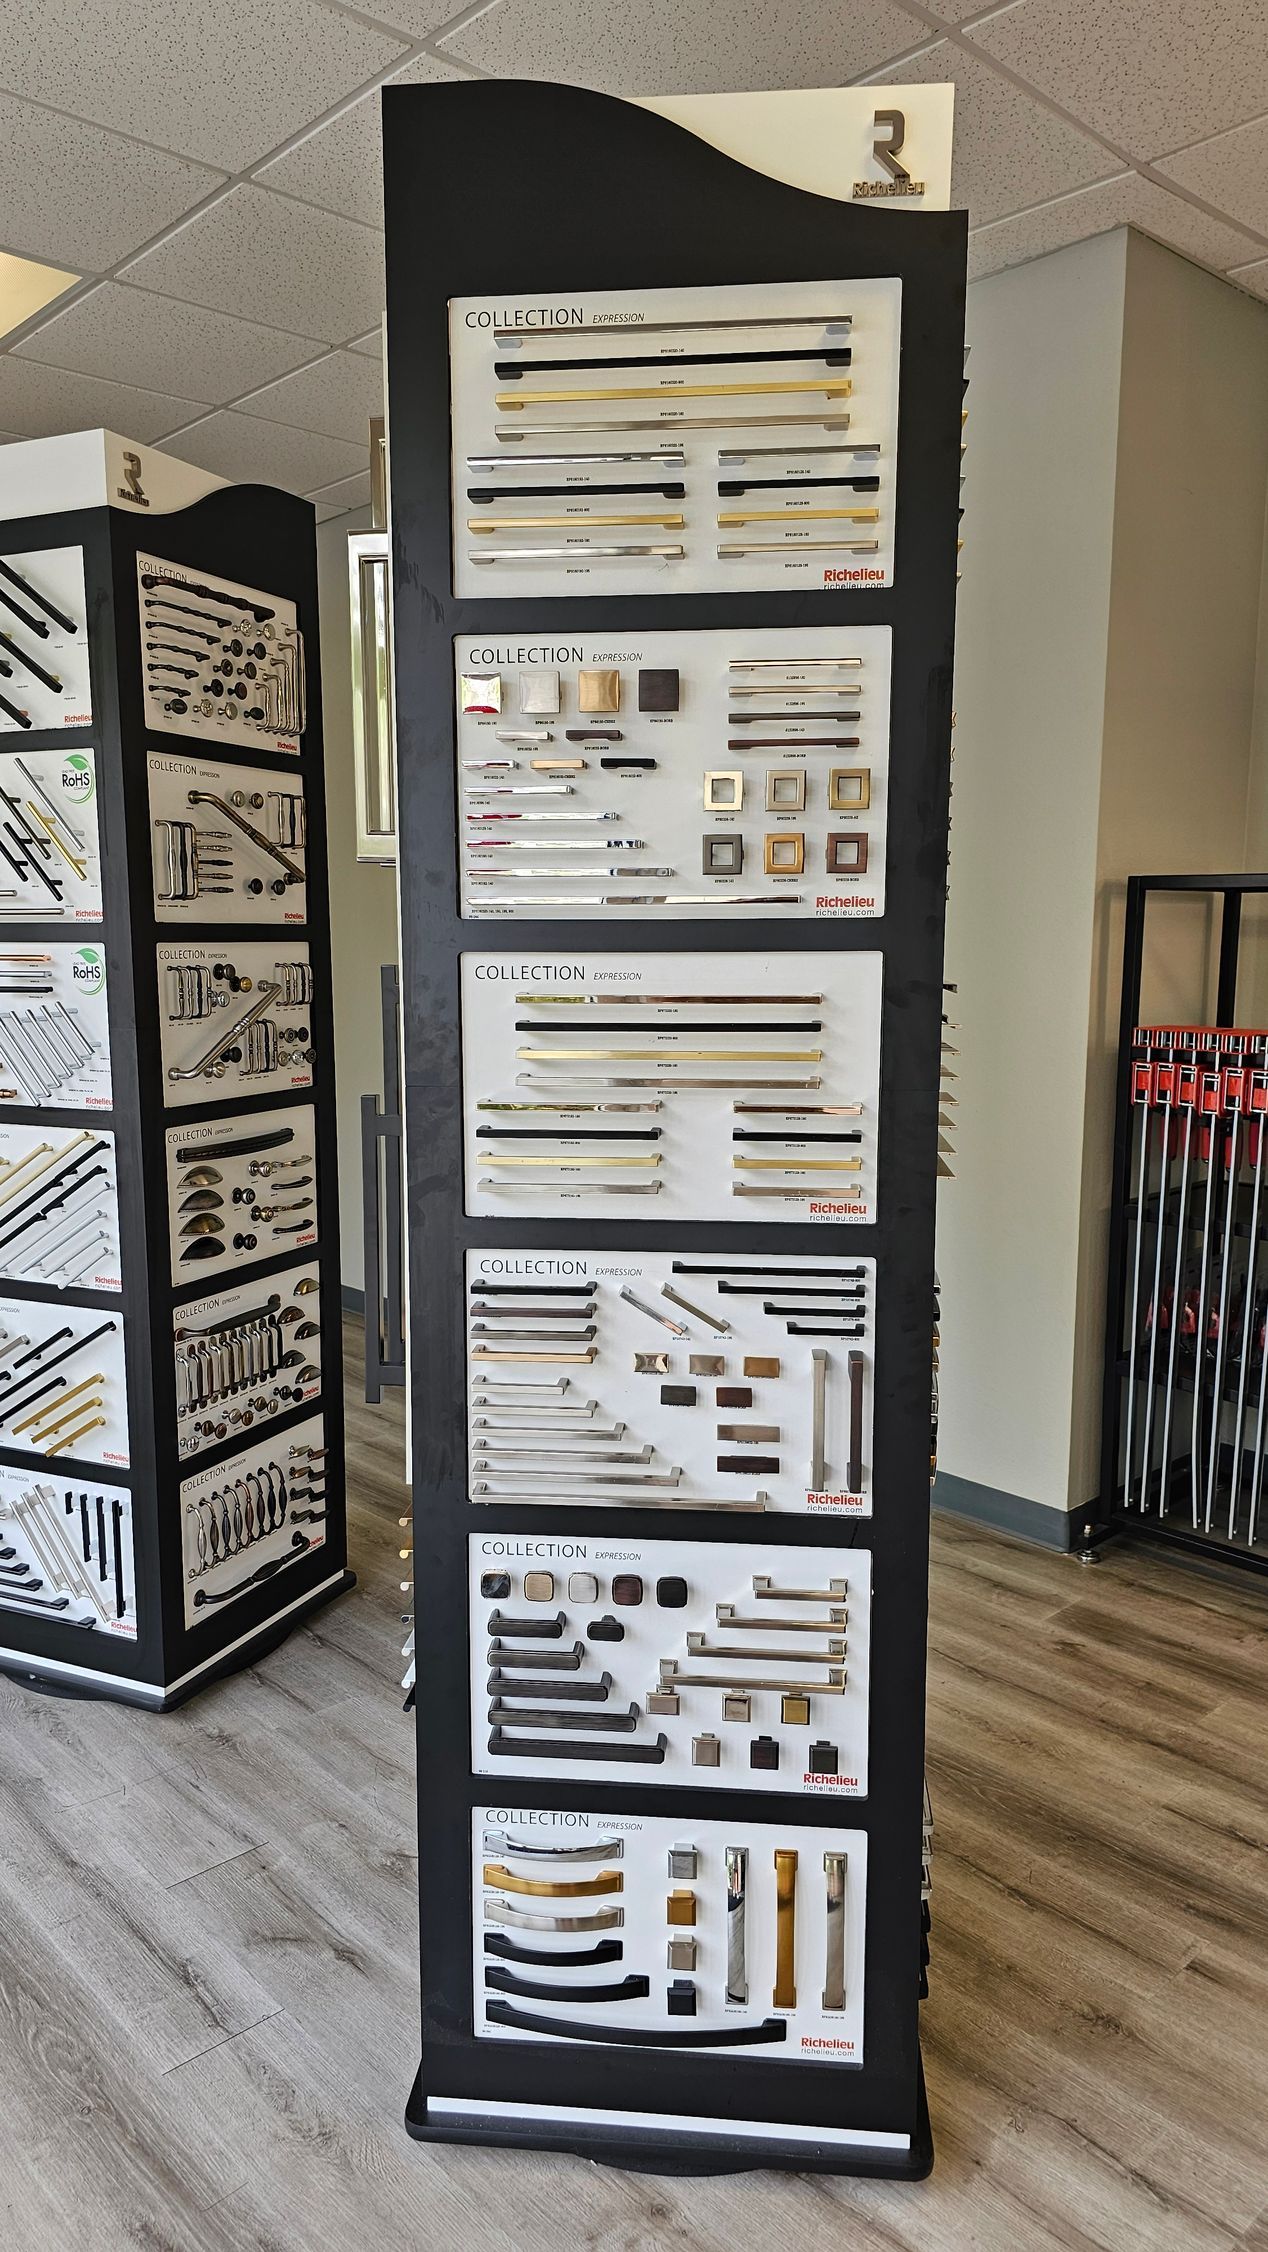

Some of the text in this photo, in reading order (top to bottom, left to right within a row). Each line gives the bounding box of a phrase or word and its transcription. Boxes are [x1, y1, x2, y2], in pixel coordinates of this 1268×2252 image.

[852, 181, 925, 199] Richelieu
[465, 307, 645, 328] COLLECTION EXPRESSION
[138, 560, 188, 584] COLLECTION
[824, 568, 885, 582] Richelieu
[469, 646, 643, 664] COLLECTION EXPRESSION
[149, 759, 198, 776] COLLECTION
[62, 772, 90, 788] RoHS
[816, 896, 875, 909] Richelieu
[816, 908, 875, 917] richelieu.com
[158, 949, 206, 961] COLLECTION
[73, 965, 101, 980] RoHS
[475, 965, 643, 981] COLLECTION EXPRESSION
[167, 1127, 213, 1144] COLLECTION
[810, 1202, 867, 1215] Richelieu
[809, 1213, 867, 1222] richelieu.com
[480, 1259, 643, 1277] COLLECTION EXPRESSION
[175, 1299, 220, 1321] COLLECTION
[182, 1464, 226, 1493] COLLECTION
[807, 1493, 863, 1506] Richelieu
[807, 1504, 863, 1514] richelieu.com
[481, 1541, 642, 1561] COLLECTION EXPRESSION
[803, 1773, 859, 1787] Richelieu
[803, 1783, 859, 1794] richelieu.com
[485, 1809, 643, 1831] COLLECTION EXPRESSION
[801, 2037, 855, 2050] Richelieu
[801, 2047, 855, 2057] richelieu.com
